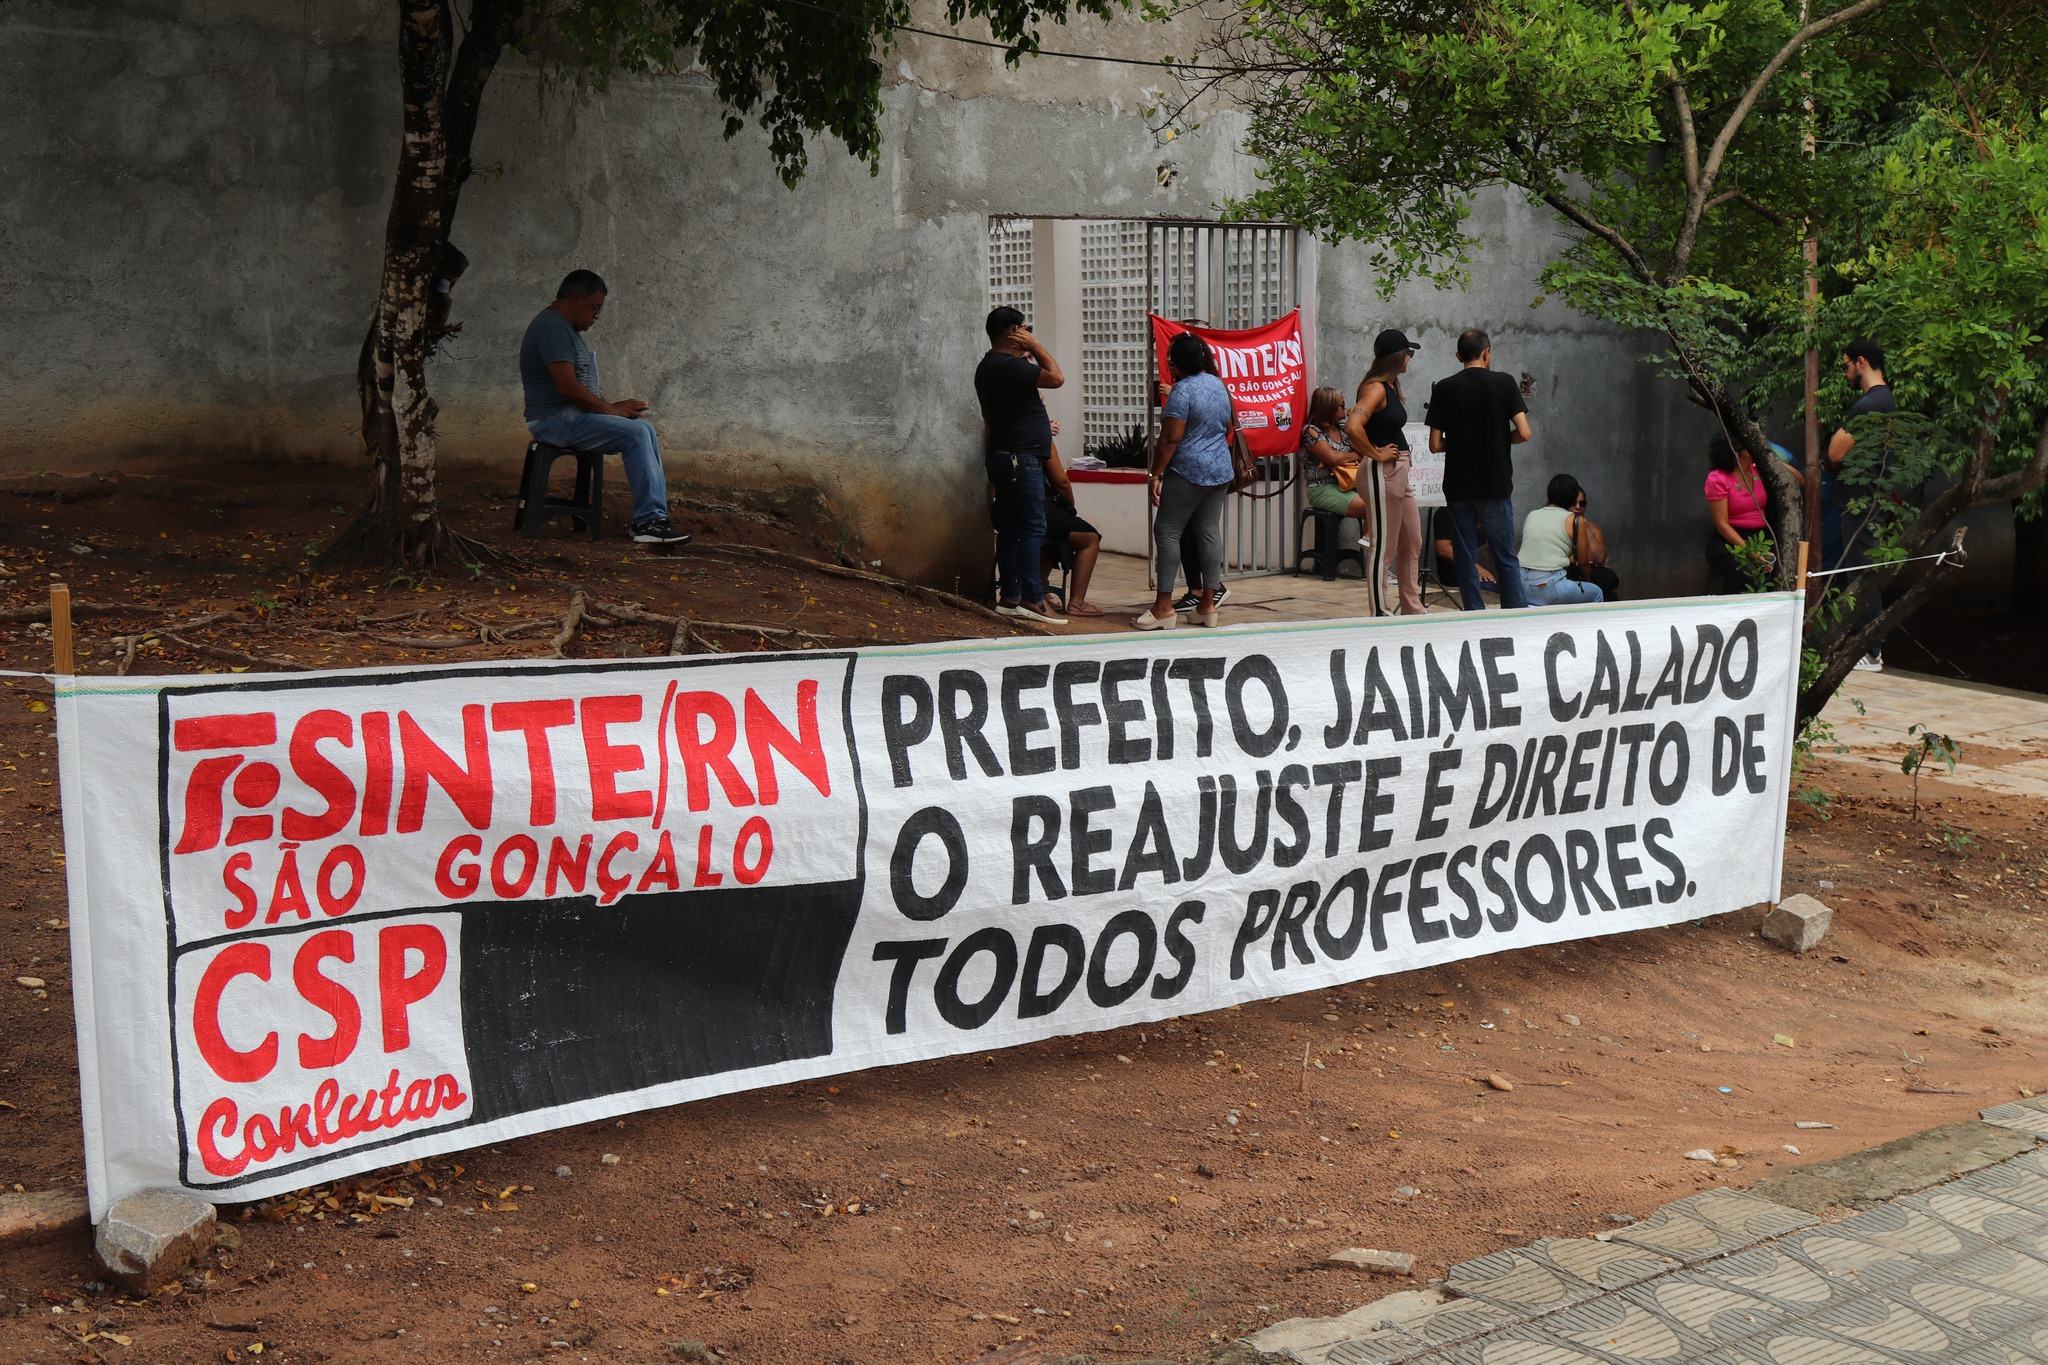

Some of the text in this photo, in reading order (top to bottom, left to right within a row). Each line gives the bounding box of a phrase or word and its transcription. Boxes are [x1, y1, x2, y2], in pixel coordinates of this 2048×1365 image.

[1238, 385, 1295, 404] AMARANTE
[1239, 380, 1260, 392] SÃO
[1275, 416, 1292, 427] Sinte
[1409, 467, 1444, 482] PROFESS
[1421, 483, 1444, 497] ENSI
[881, 618, 1759, 789] PREFEITO, JAIME CALADO
[281, 679, 831, 842] SINTE/RN
[223, 815, 774, 930] SÃO GONÇALO
[889, 713, 1767, 922] O REAJUSTE É DIREITO DE
[871, 817, 1698, 1035] TODOS PROFESSORES.
[192, 923, 448, 1083] CSP
[196, 1068, 467, 1178] Conlutas
